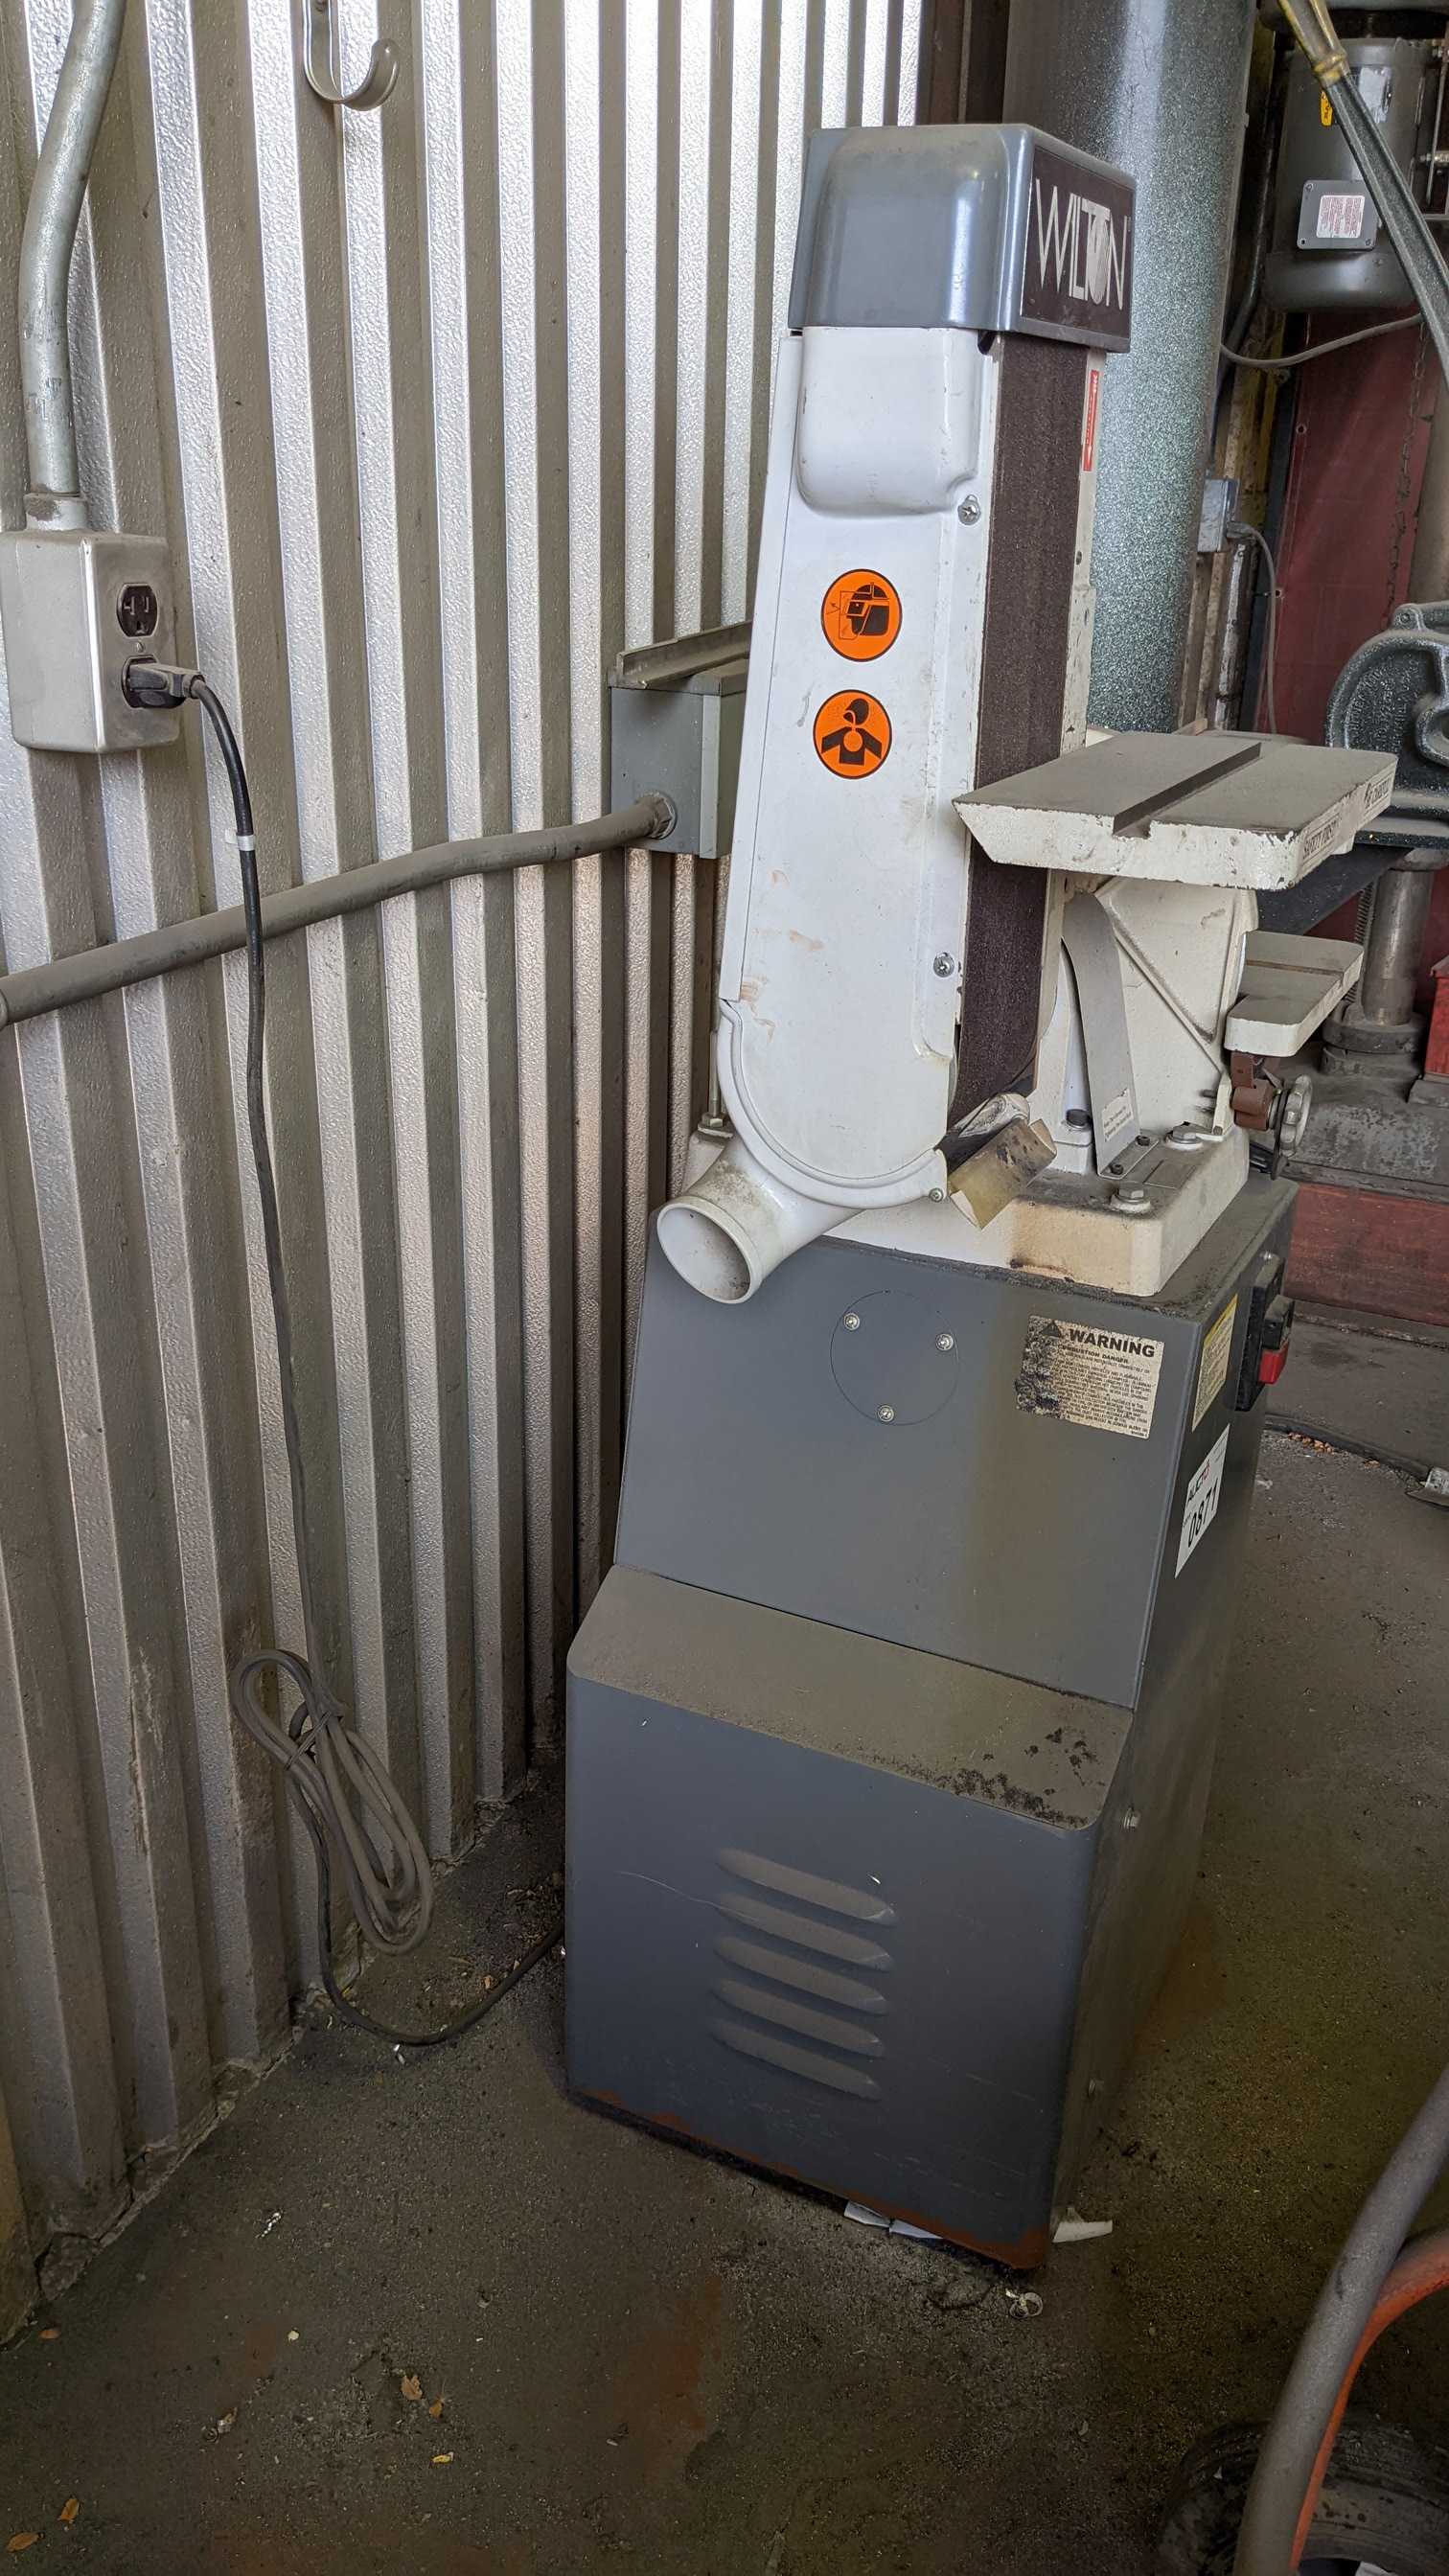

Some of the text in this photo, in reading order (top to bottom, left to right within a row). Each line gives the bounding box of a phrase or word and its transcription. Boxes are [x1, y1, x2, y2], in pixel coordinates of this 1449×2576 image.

[1036, 178, 1128, 310] WILTON
[1070, 1328, 1155, 1357] WARNING
[1188, 1477, 1219, 1548] 0871
